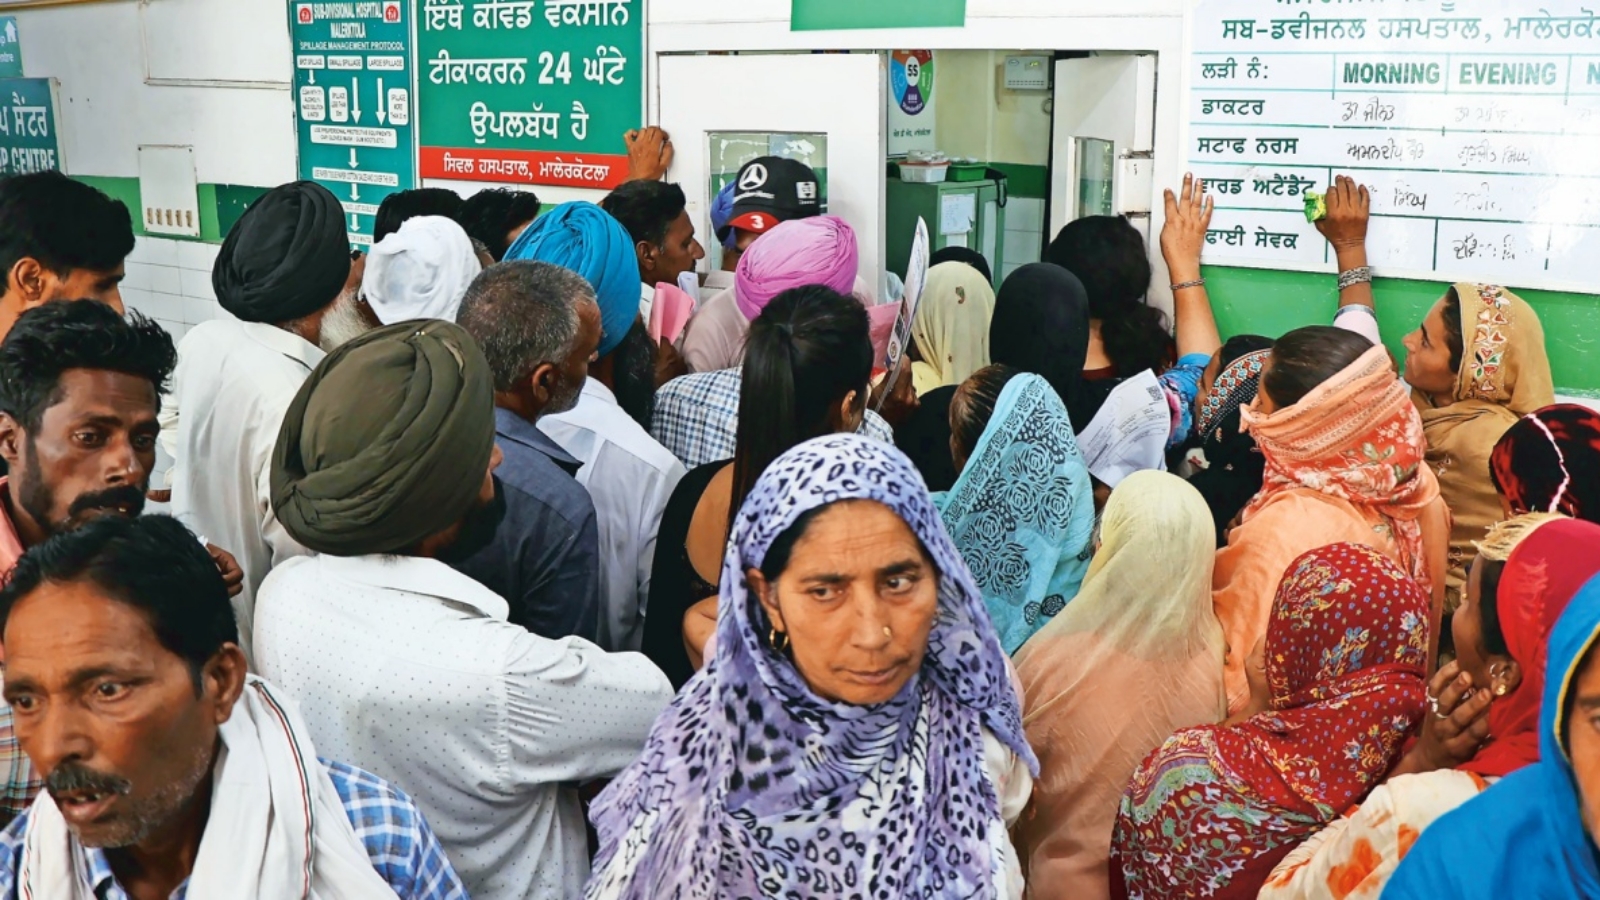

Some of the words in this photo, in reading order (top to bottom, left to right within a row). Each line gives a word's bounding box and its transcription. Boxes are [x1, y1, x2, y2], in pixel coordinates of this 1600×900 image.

[355, 2, 382, 18] HOSPITAL
[1378, 17, 1492, 43] ਹਸਪਤਾਲ,
[1504, 7, 1600, 39] ਮਾਲੇਰਕੋ
[300, 42, 327, 51] SPILLAGE
[328, 42, 370, 51] MANAGEMENT
[371, 42, 405, 51] PROTOCOL
[428, 49, 527, 84] ਟੀਕਾਕਰਨ
[538, 51, 572, 84] 24
[583, 46, 626, 85] ਘੰਟੇ
[907, 64, 918, 77] 5S
[1202, 57, 1237, 79] ਲੜੀ
[1343, 62, 1440, 85] MORNING
[1459, 62, 1557, 86] EVENING
[12, 91, 47, 136] ਸੈਂਟਰ
[1202, 99, 1265, 115] ਡਾਕਟਰ
[470, 101, 560, 144] ਉਪਲਬੱਧ
[570, 101, 590, 140] ਹੈ
[1198, 138, 1247, 154] ਸਟਾਫ
[1256, 138, 1299, 154] ਨਰਸ
[11, 147, 55, 174] CENTRE
[443, 152, 474, 173] ਸਿਵਲ
[478, 158, 533, 180] ਹਸਪਤਾਲ,
[539, 157, 610, 181] ਮਾਲੇਰਕੋਟਲਾ
[750, 215, 764, 229] 3
[1205, 225, 1246, 246] ਫਾਈ
[1255, 226, 1299, 249] ਸੇਵਕ
